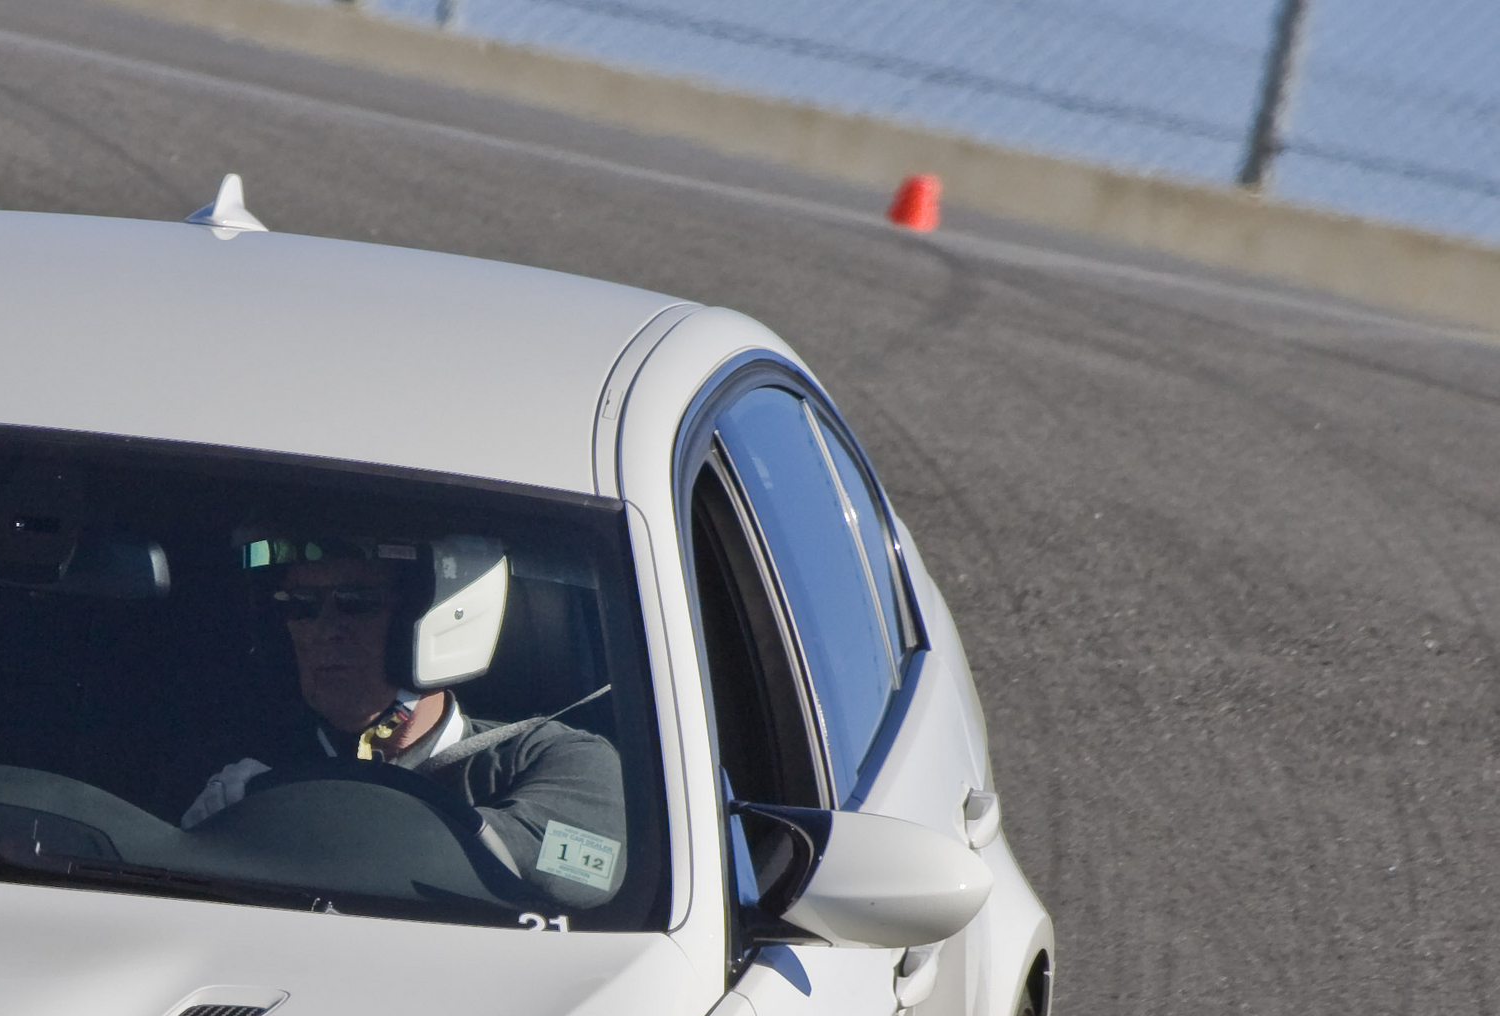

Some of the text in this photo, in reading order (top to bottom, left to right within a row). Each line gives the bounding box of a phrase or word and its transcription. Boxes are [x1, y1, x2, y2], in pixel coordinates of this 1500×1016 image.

[569, 834, 585, 844] CAR
[557, 843, 604, 871] 1 12
